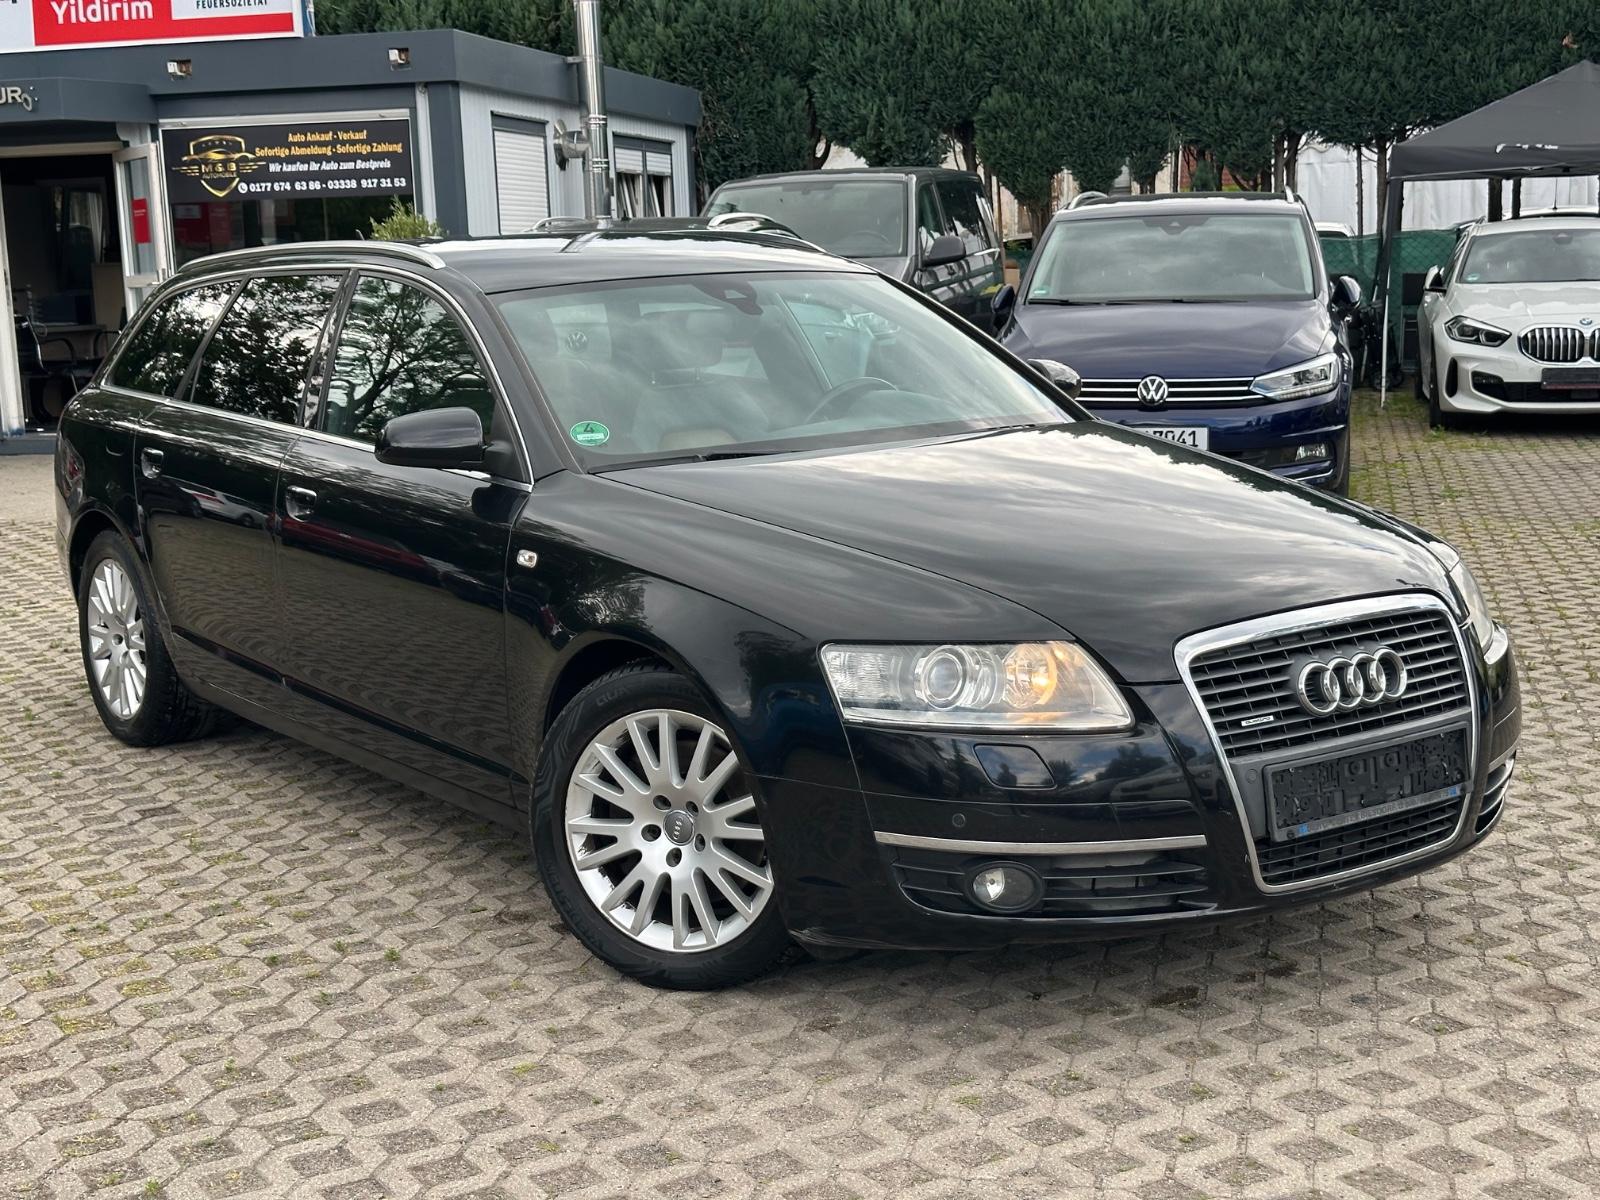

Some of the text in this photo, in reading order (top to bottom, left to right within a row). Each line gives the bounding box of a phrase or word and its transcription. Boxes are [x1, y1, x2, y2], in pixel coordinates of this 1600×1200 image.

[50, 0, 153, 25] Yildirim
[287, 132, 306, 143] Auto
[307, 130, 333, 142] Ankauf
[338, 129, 367, 140] Verkauf
[255, 147, 290, 158] Sofortige
[290, 144, 332, 157] Abmeldung
[336, 143, 372, 155] Sofortige
[372, 141, 403, 154] Zahlung
[268, 162, 282, 173] Wir
[282, 161, 309, 172] kaufen
[320, 160, 338, 171] Auto
[338, 160, 355, 170] zum
[355, 158, 391, 171] Bestpreis
[249, 182, 271, 192] 0177
[273, 181, 291, 192] 674
[294, 180, 308, 191] 63
[308, 180, 322, 191] 86
[327, 178, 358, 190] 03338
[360, 178, 378, 189] 917
[379, 177, 393, 188] 31
[393, 177, 407, 188] 53
[583, 423, 595, 433] 4
